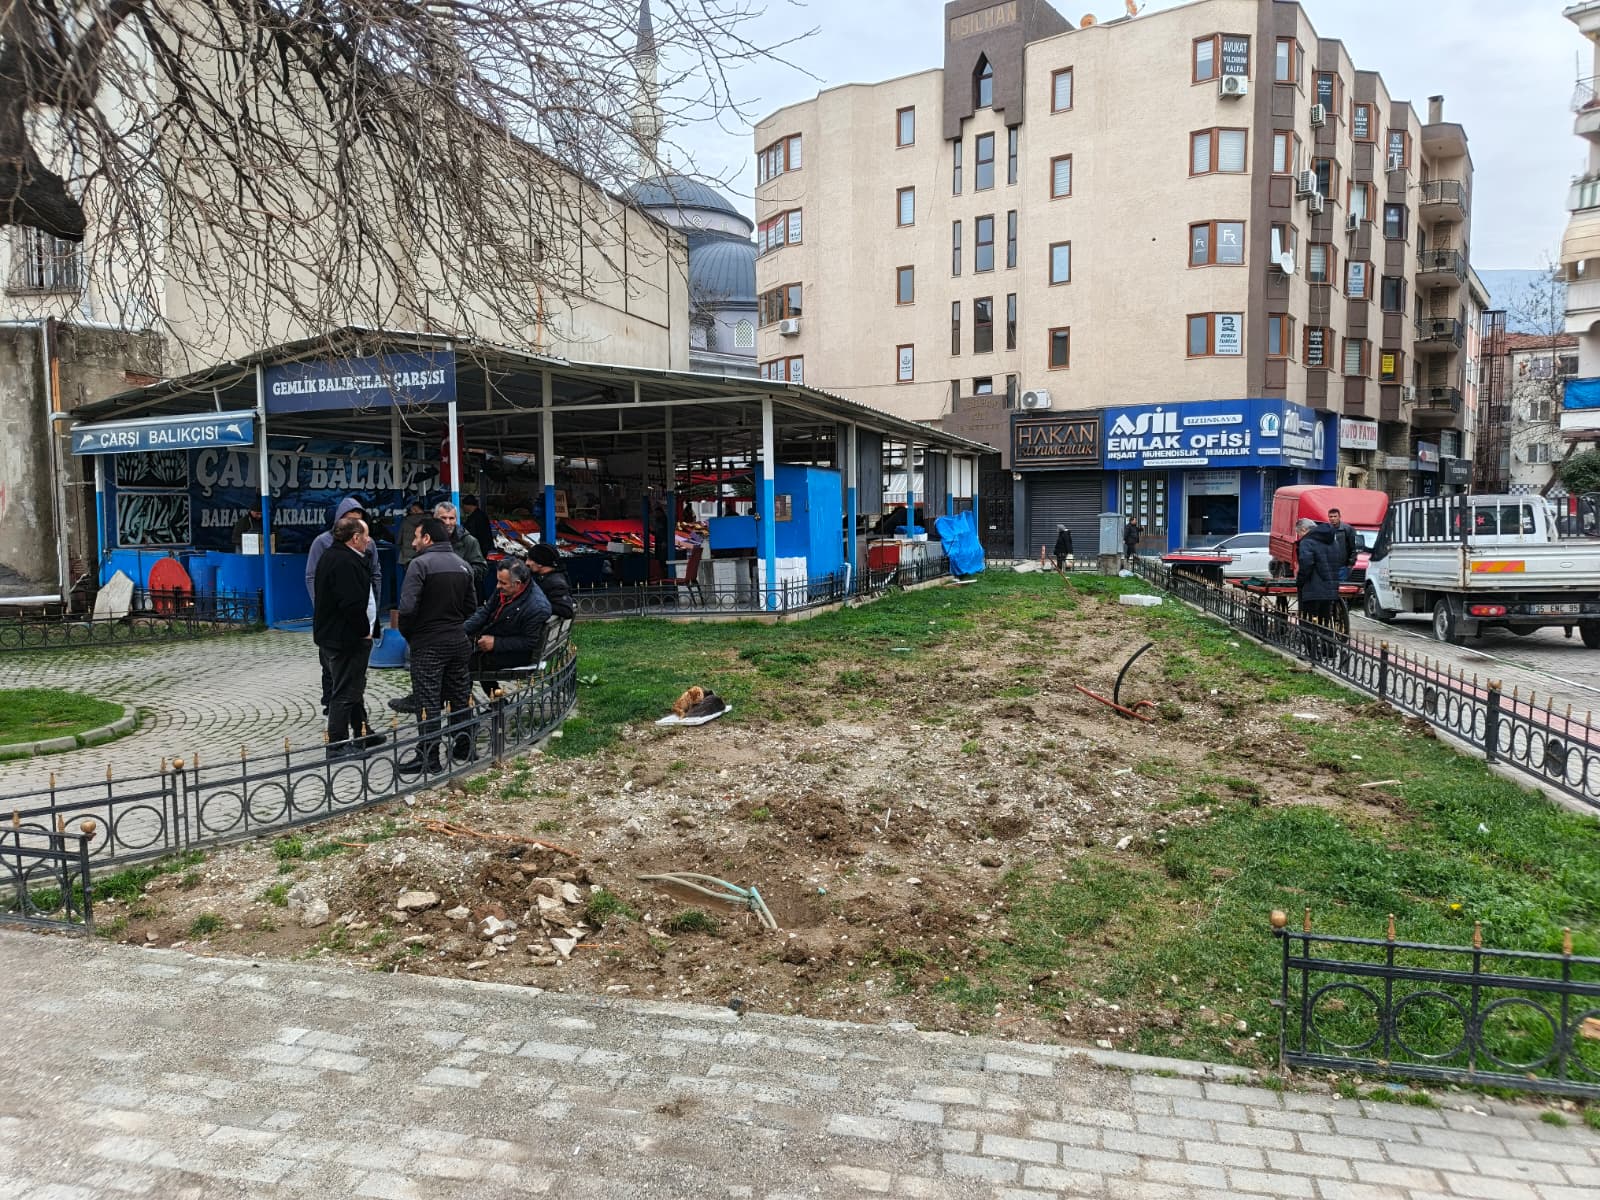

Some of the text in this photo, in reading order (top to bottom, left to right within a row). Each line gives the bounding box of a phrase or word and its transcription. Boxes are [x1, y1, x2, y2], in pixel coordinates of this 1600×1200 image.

[1222, 41, 1248, 53] AVUKAT
[1225, 64, 1244, 73] KALFA
[272, 375, 317, 396] GEMLİK
[394, 369, 446, 391] ÇARŞISI
[1109, 406, 1184, 436] ASİL
[100, 425, 219, 448] ÇARŞI BALIKÇISI
[1019, 423, 1094, 445] HAKAN
[1107, 429, 1252, 451] EMLAK OFİSİ
[273, 508, 326, 525] AKBALIK
